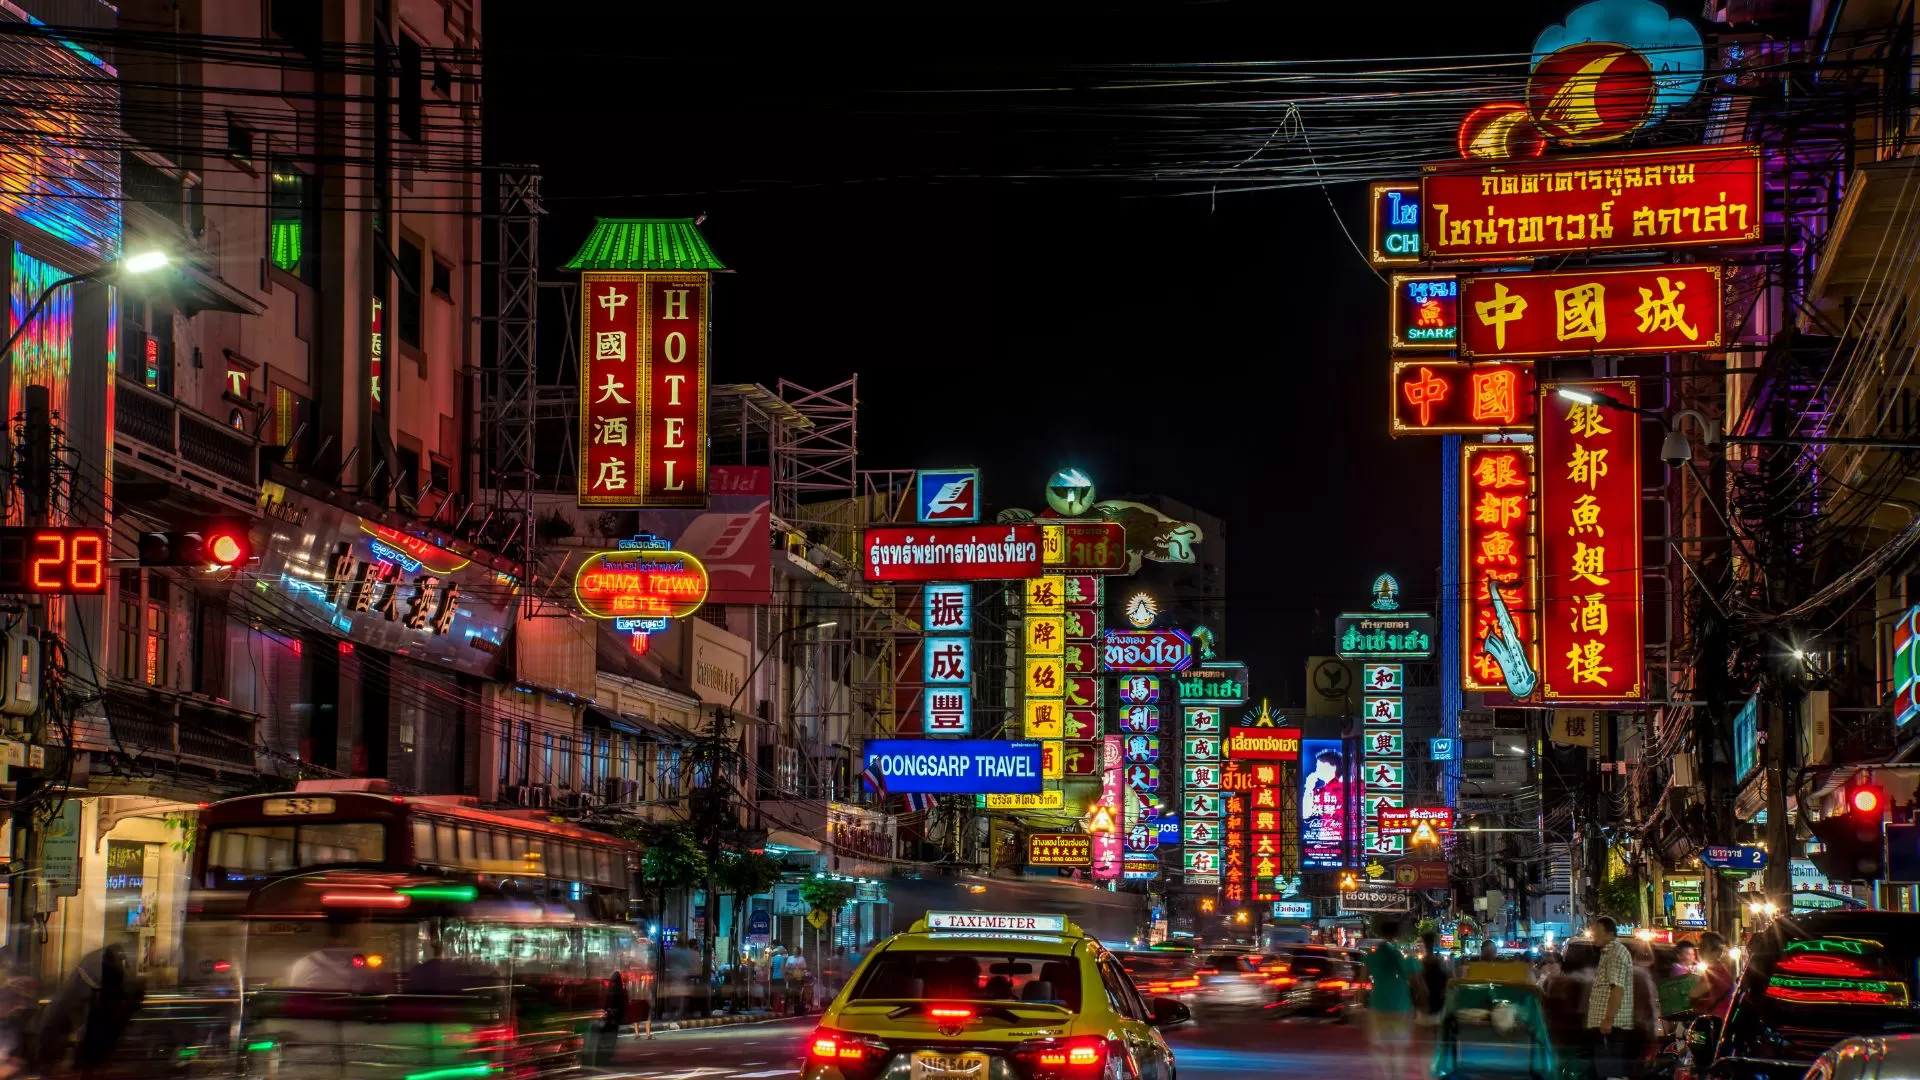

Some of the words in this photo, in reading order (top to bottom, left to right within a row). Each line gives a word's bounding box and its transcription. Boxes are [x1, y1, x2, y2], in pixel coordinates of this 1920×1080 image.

[1386, 234, 1419, 253] CH
[1433, 200, 1615, 247] ไชน่าทาวน์
[1632, 191, 1749, 238] สกาล่า
[1474, 276, 1699, 351] 中國城
[592, 286, 632, 491] 中國大酒店
[662, 289, 690, 491] HOTEL
[1404, 366, 1517, 427] 中國
[33, 535, 103, 589] 28
[870, 527, 1037, 577] รุ่งทรัพย์การท่องเที่ยว
[1564, 399, 1616, 688] 銀都魚翅酒樓
[584, 574, 641, 593] CHINA
[649, 574, 700, 595] TOWN
[613, 595, 670, 612] HOTEL
[930, 591, 966, 730] 振成豐
[974, 755, 1036, 777] TRAVEL
[284, 798, 314, 816] 53
[1257, 766, 1276, 900] 聯成興大金
[1752, 851, 1761, 863] 2
[947, 915, 1036, 929] TAXI-METER
